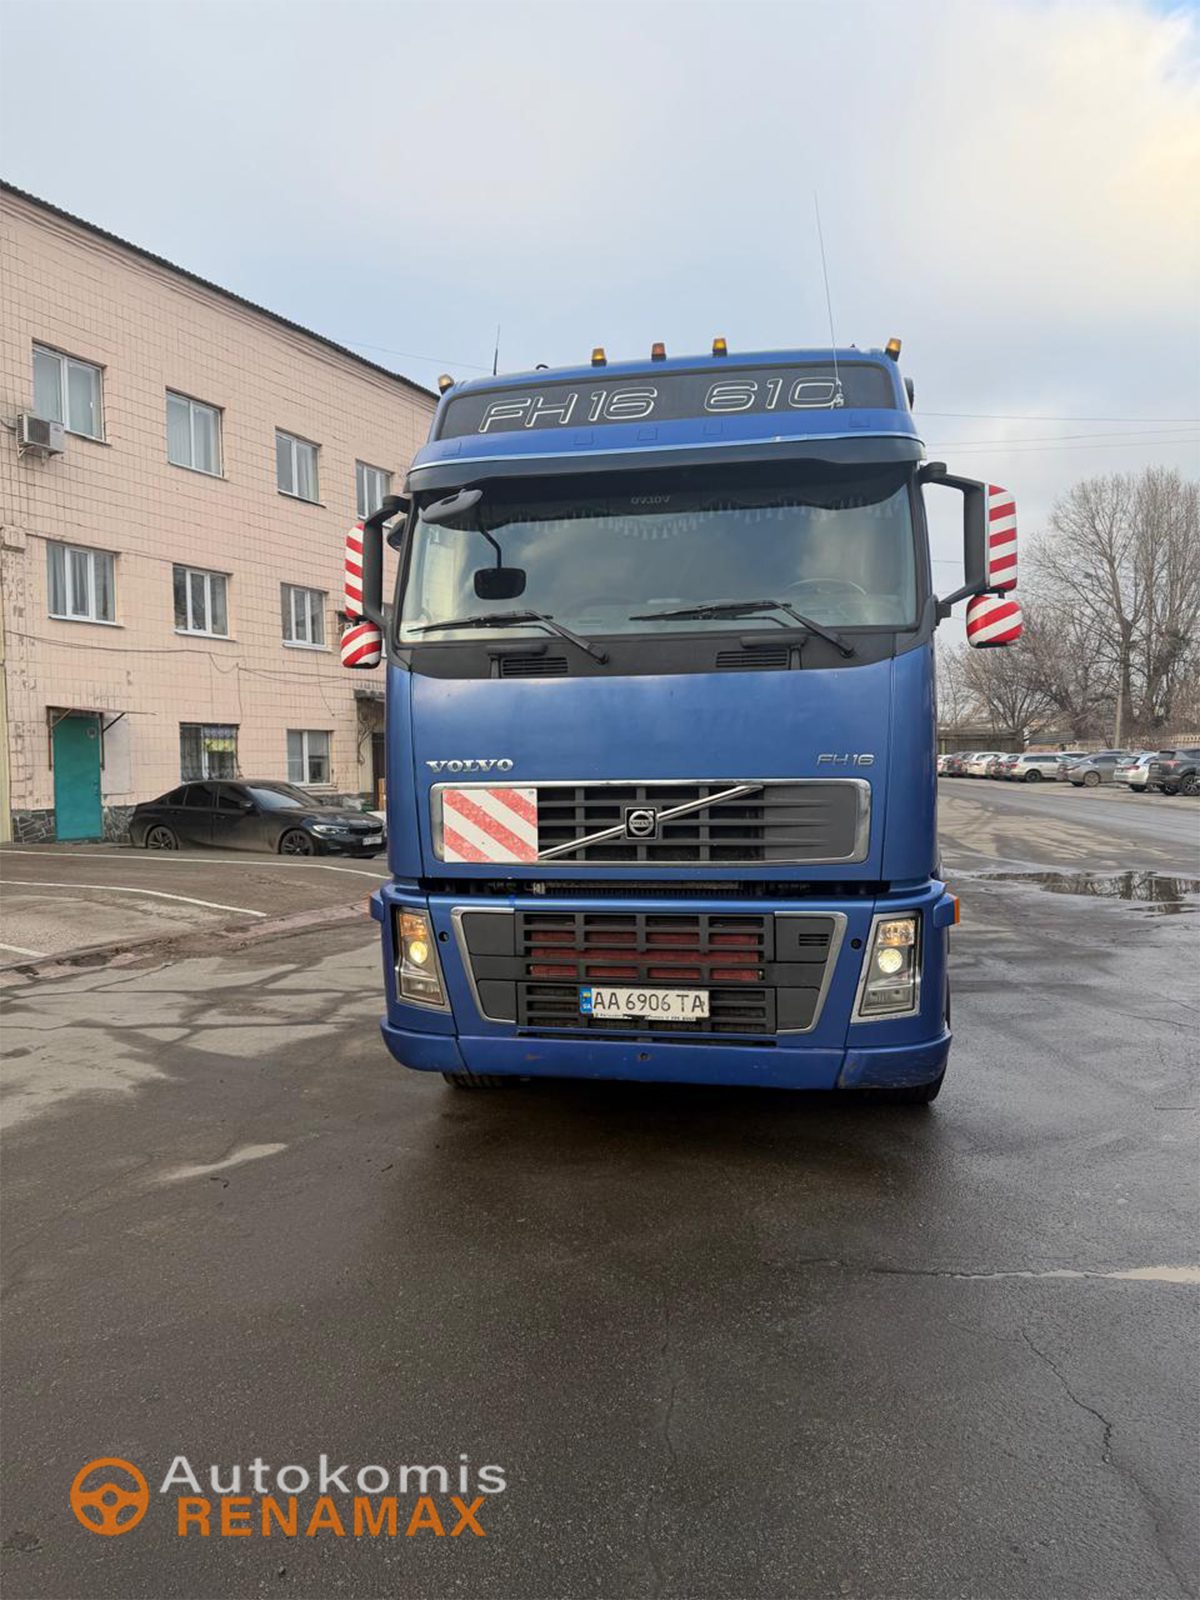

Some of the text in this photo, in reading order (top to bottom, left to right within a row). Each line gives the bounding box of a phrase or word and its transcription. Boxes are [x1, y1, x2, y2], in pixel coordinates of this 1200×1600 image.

[704, 376, 837, 412] 610
[425, 758, 514, 773] VOLVO
[593, 991, 705, 1013] AA 6906 TA
